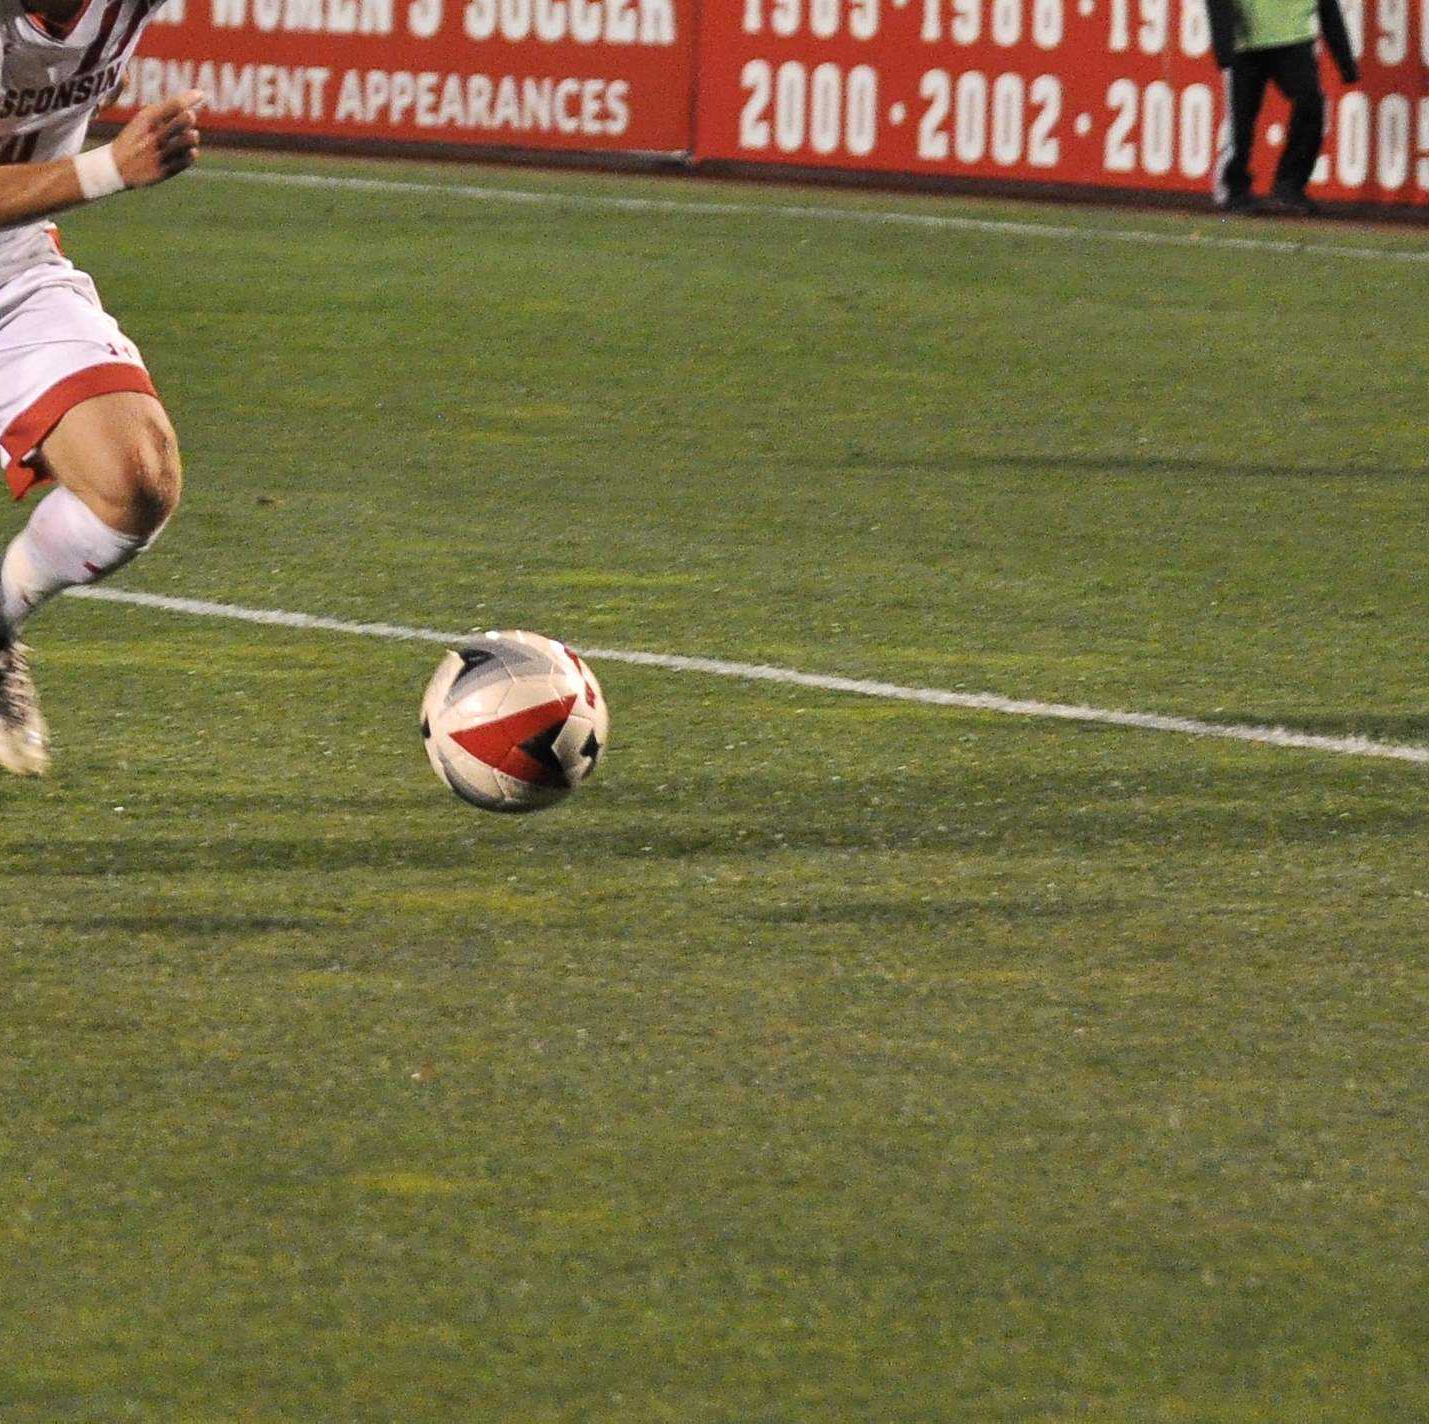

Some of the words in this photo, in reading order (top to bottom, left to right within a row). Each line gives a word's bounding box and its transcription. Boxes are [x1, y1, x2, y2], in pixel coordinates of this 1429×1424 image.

[335, 68, 631, 135] APPEARANCES
[739, 58, 879, 156] 2000
[916, 68, 1062, 168] 2002
[1103, 79, 1215, 179] 200
